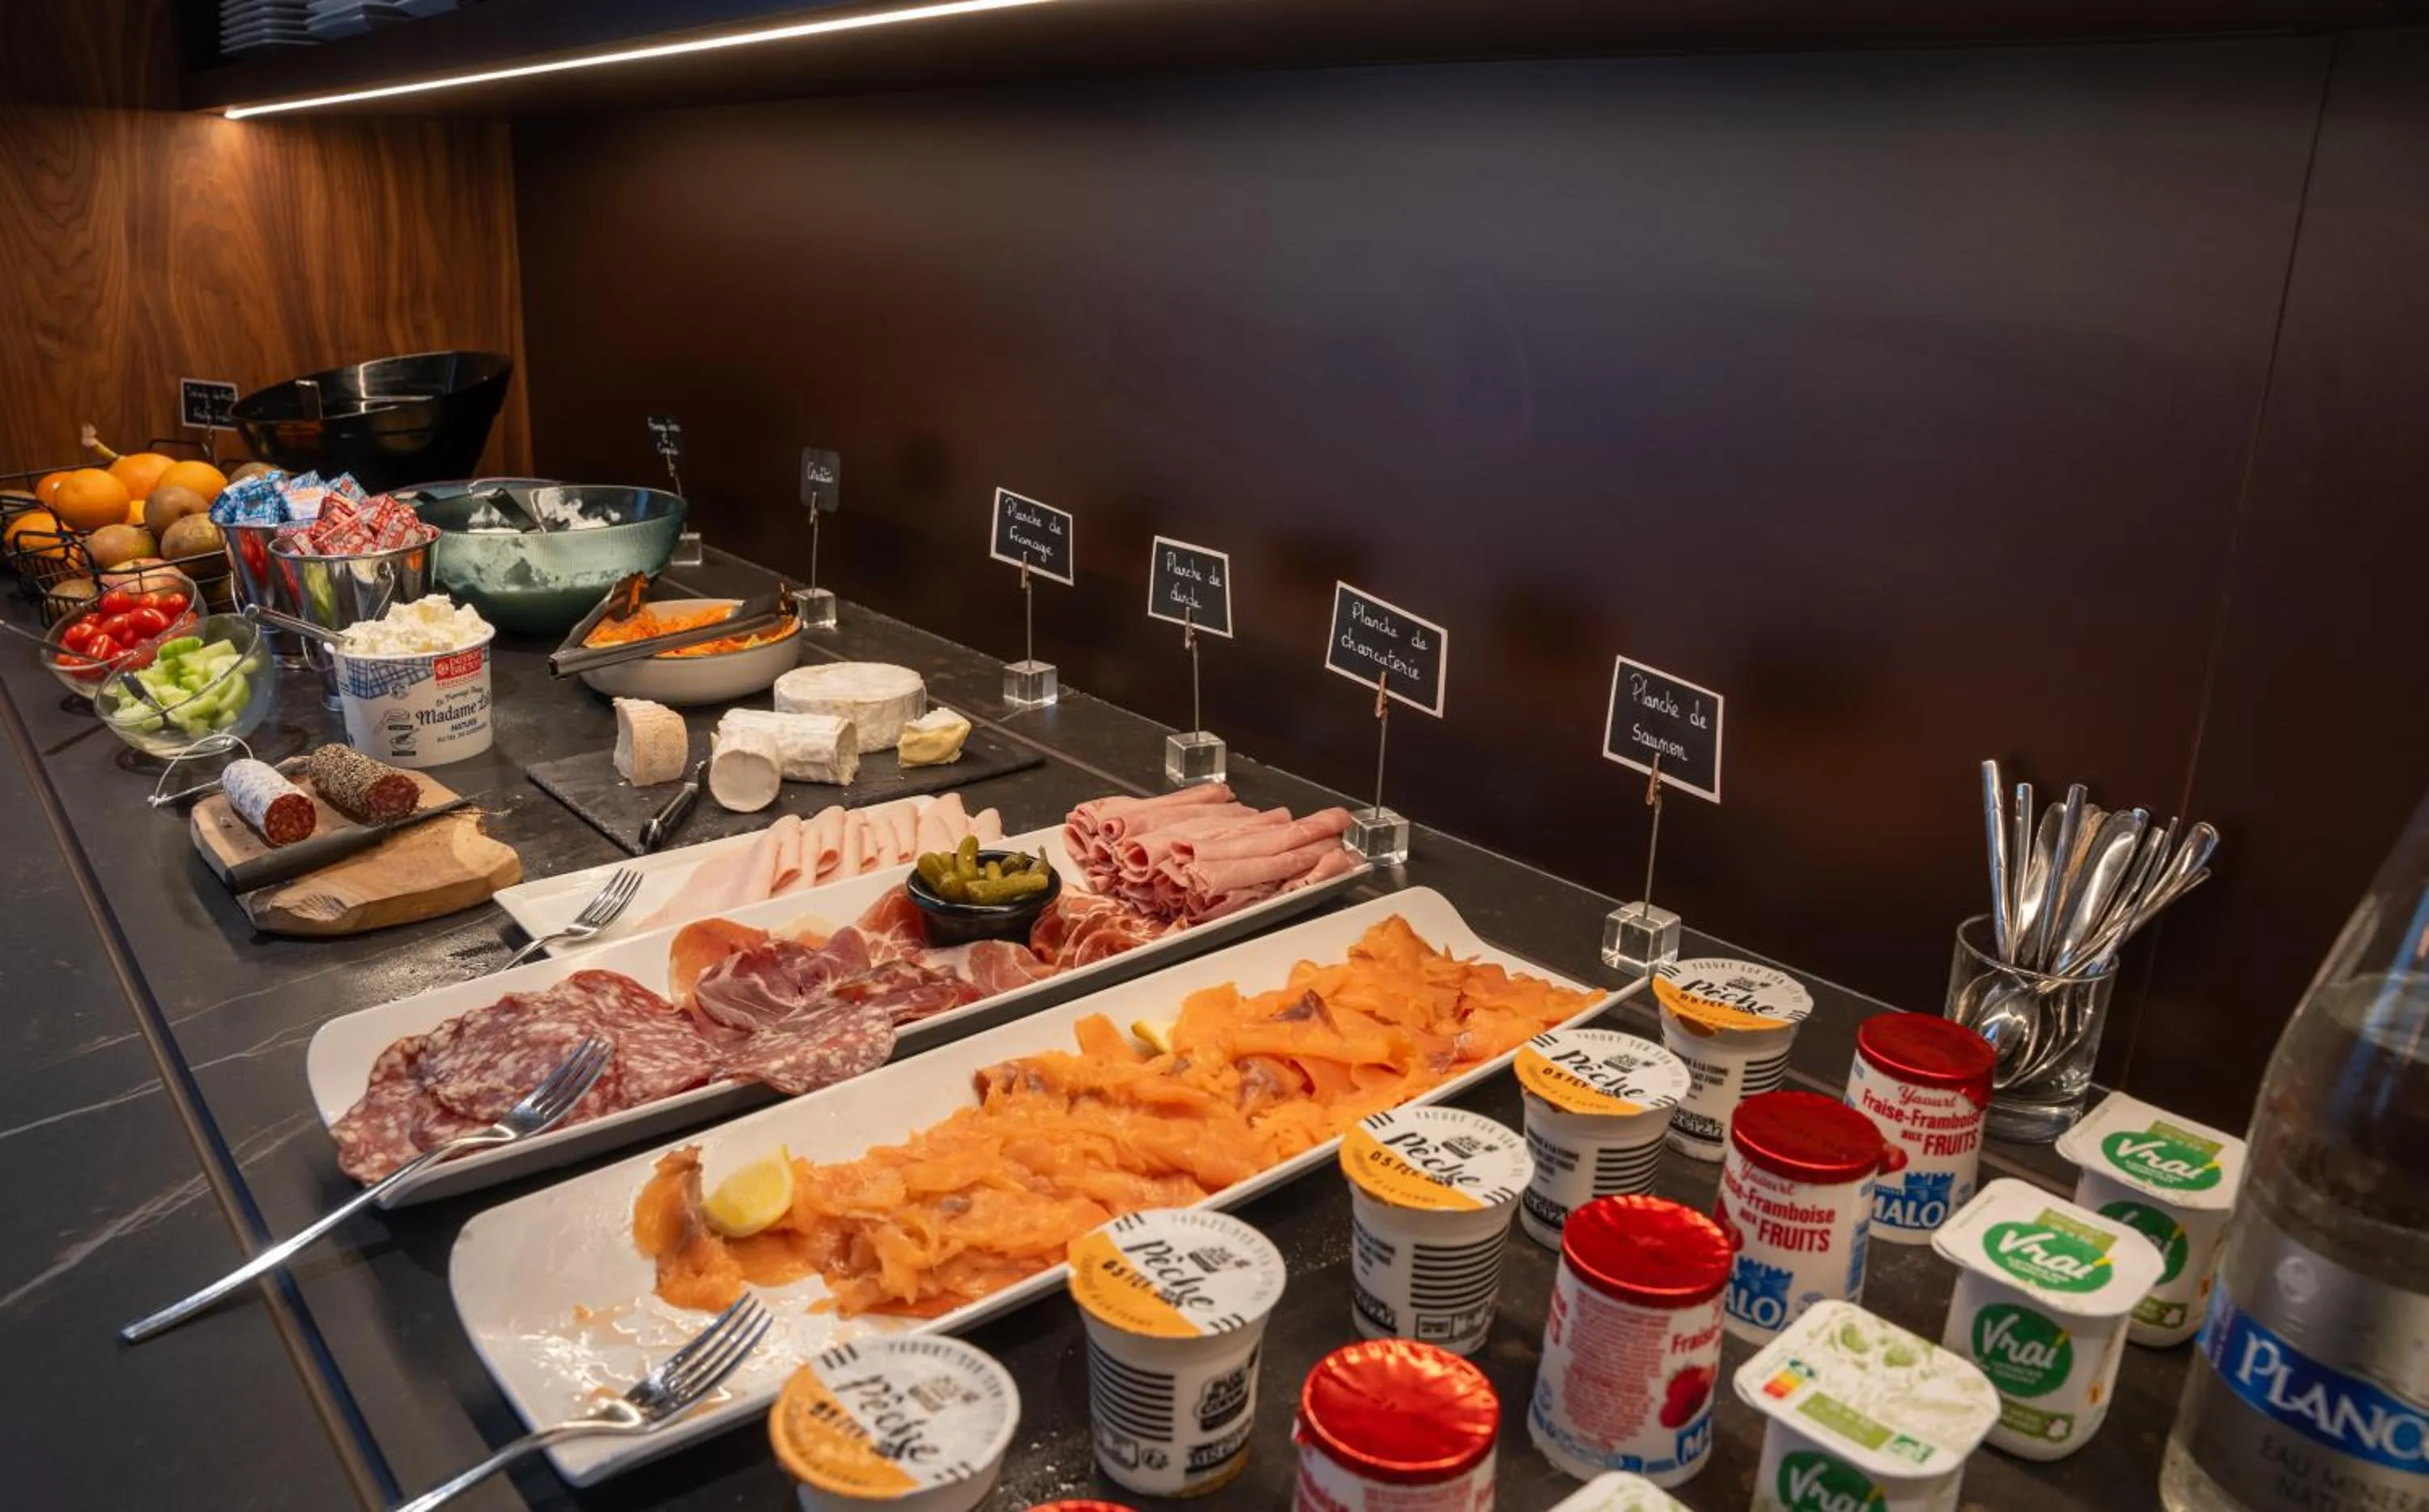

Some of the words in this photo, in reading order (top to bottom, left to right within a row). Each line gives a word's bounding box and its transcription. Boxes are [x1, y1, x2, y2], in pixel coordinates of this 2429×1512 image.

[1005, 497, 1042, 528] Planche
[1049, 516, 1062, 535] de
[1166, 551, 1202, 581] Planche
[1209, 565, 1221, 587] de
[1352, 601, 1399, 637] Planche
[1411, 630, 1428, 650] de
[415, 703, 476, 726] Madame
[1630, 673, 1680, 718] Planche
[1690, 699, 1708, 729] de
[1922, 1128, 1978, 1157] FRUITS
[2116, 1137, 2206, 1179] Vrai
[1758, 1218, 1832, 1253] FRUITS
[1997, 1229, 2095, 1279] Vrai
[1983, 1313, 2059, 1370] Vrai
[2235, 1330, 2429, 1461] PLANC
